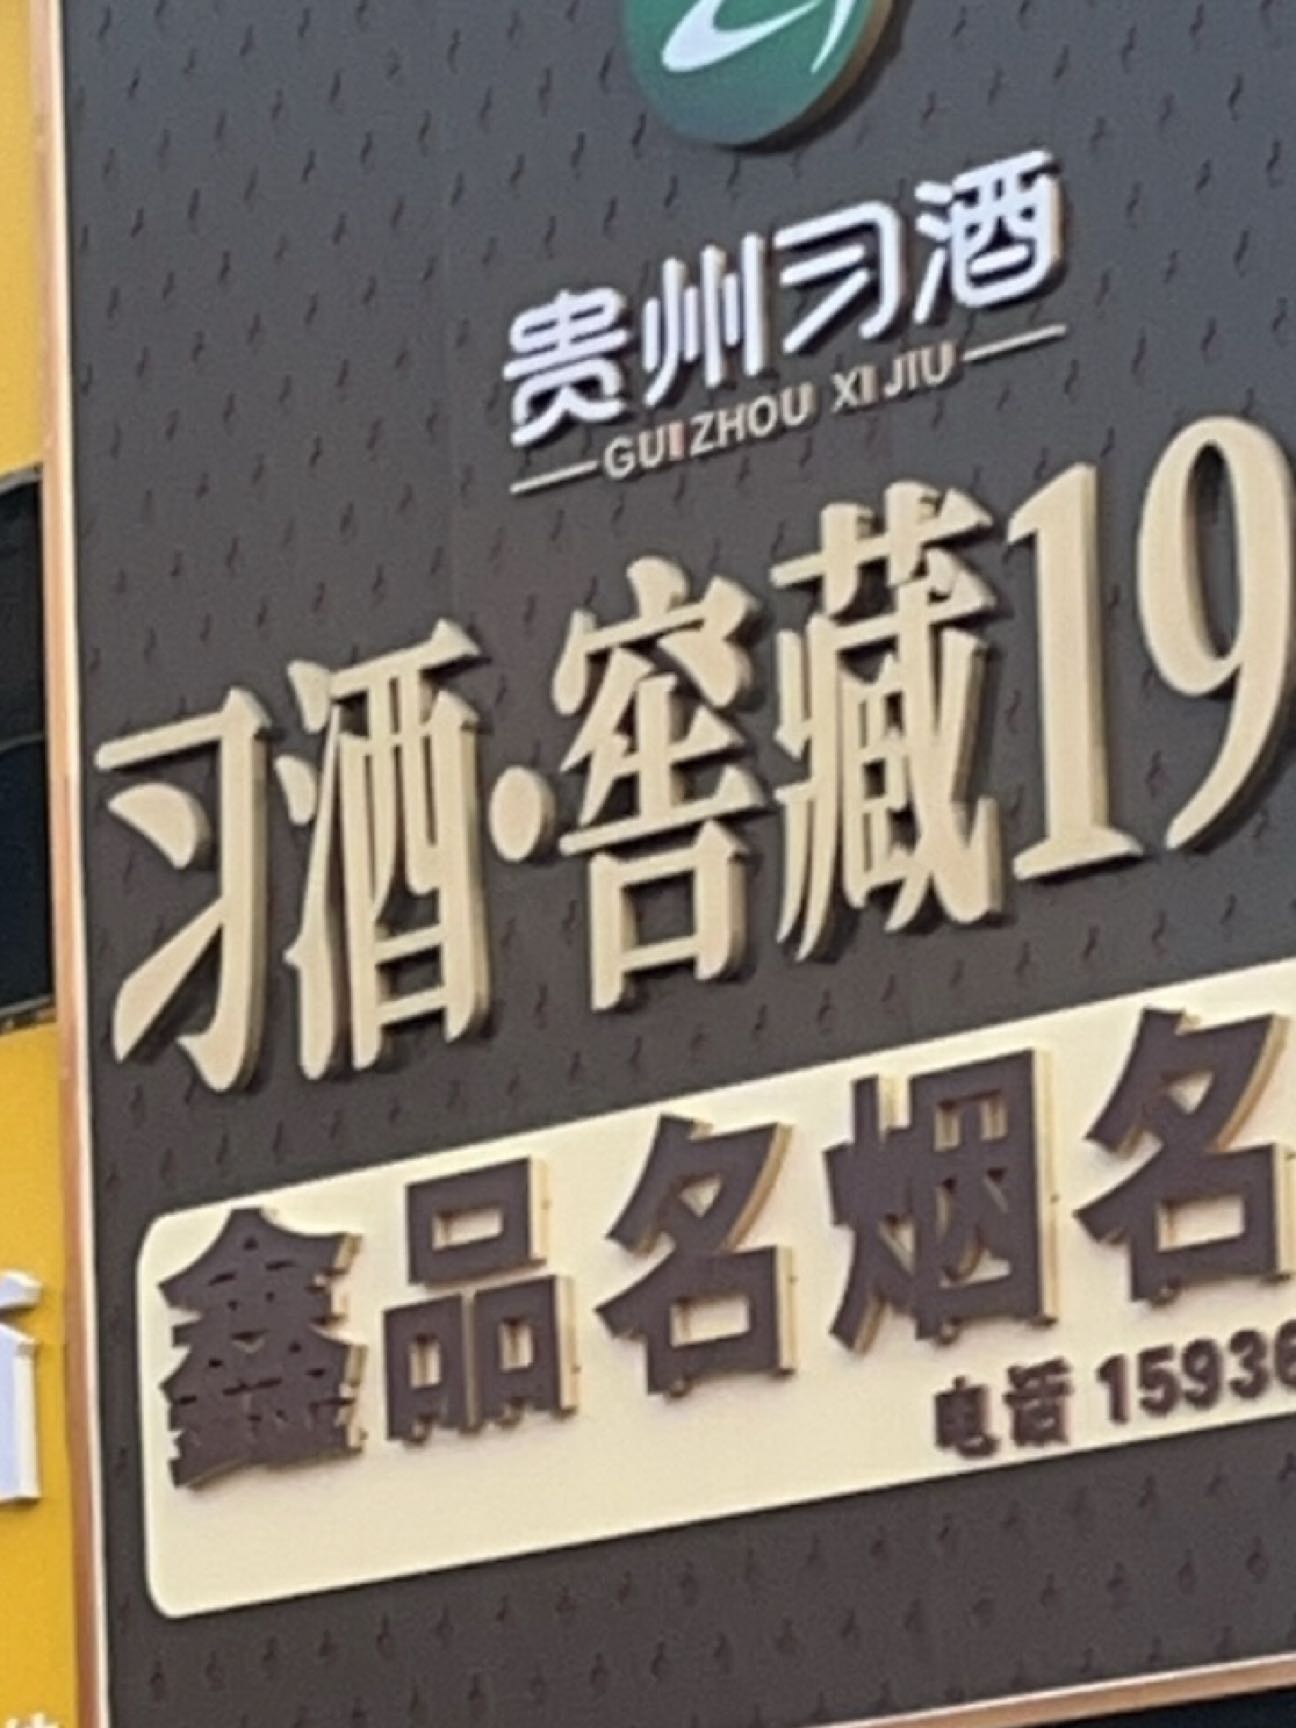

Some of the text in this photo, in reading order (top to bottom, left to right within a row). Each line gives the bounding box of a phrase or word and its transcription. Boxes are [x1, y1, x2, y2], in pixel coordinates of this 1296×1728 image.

[504, 150, 1061, 447] 贵州习酒
[604, 381, 819, 479] GUIZHOU
[157, 1007, 1294, 1489] 鑫品名烟名
[934, 1354, 1073, 1457] 电话
